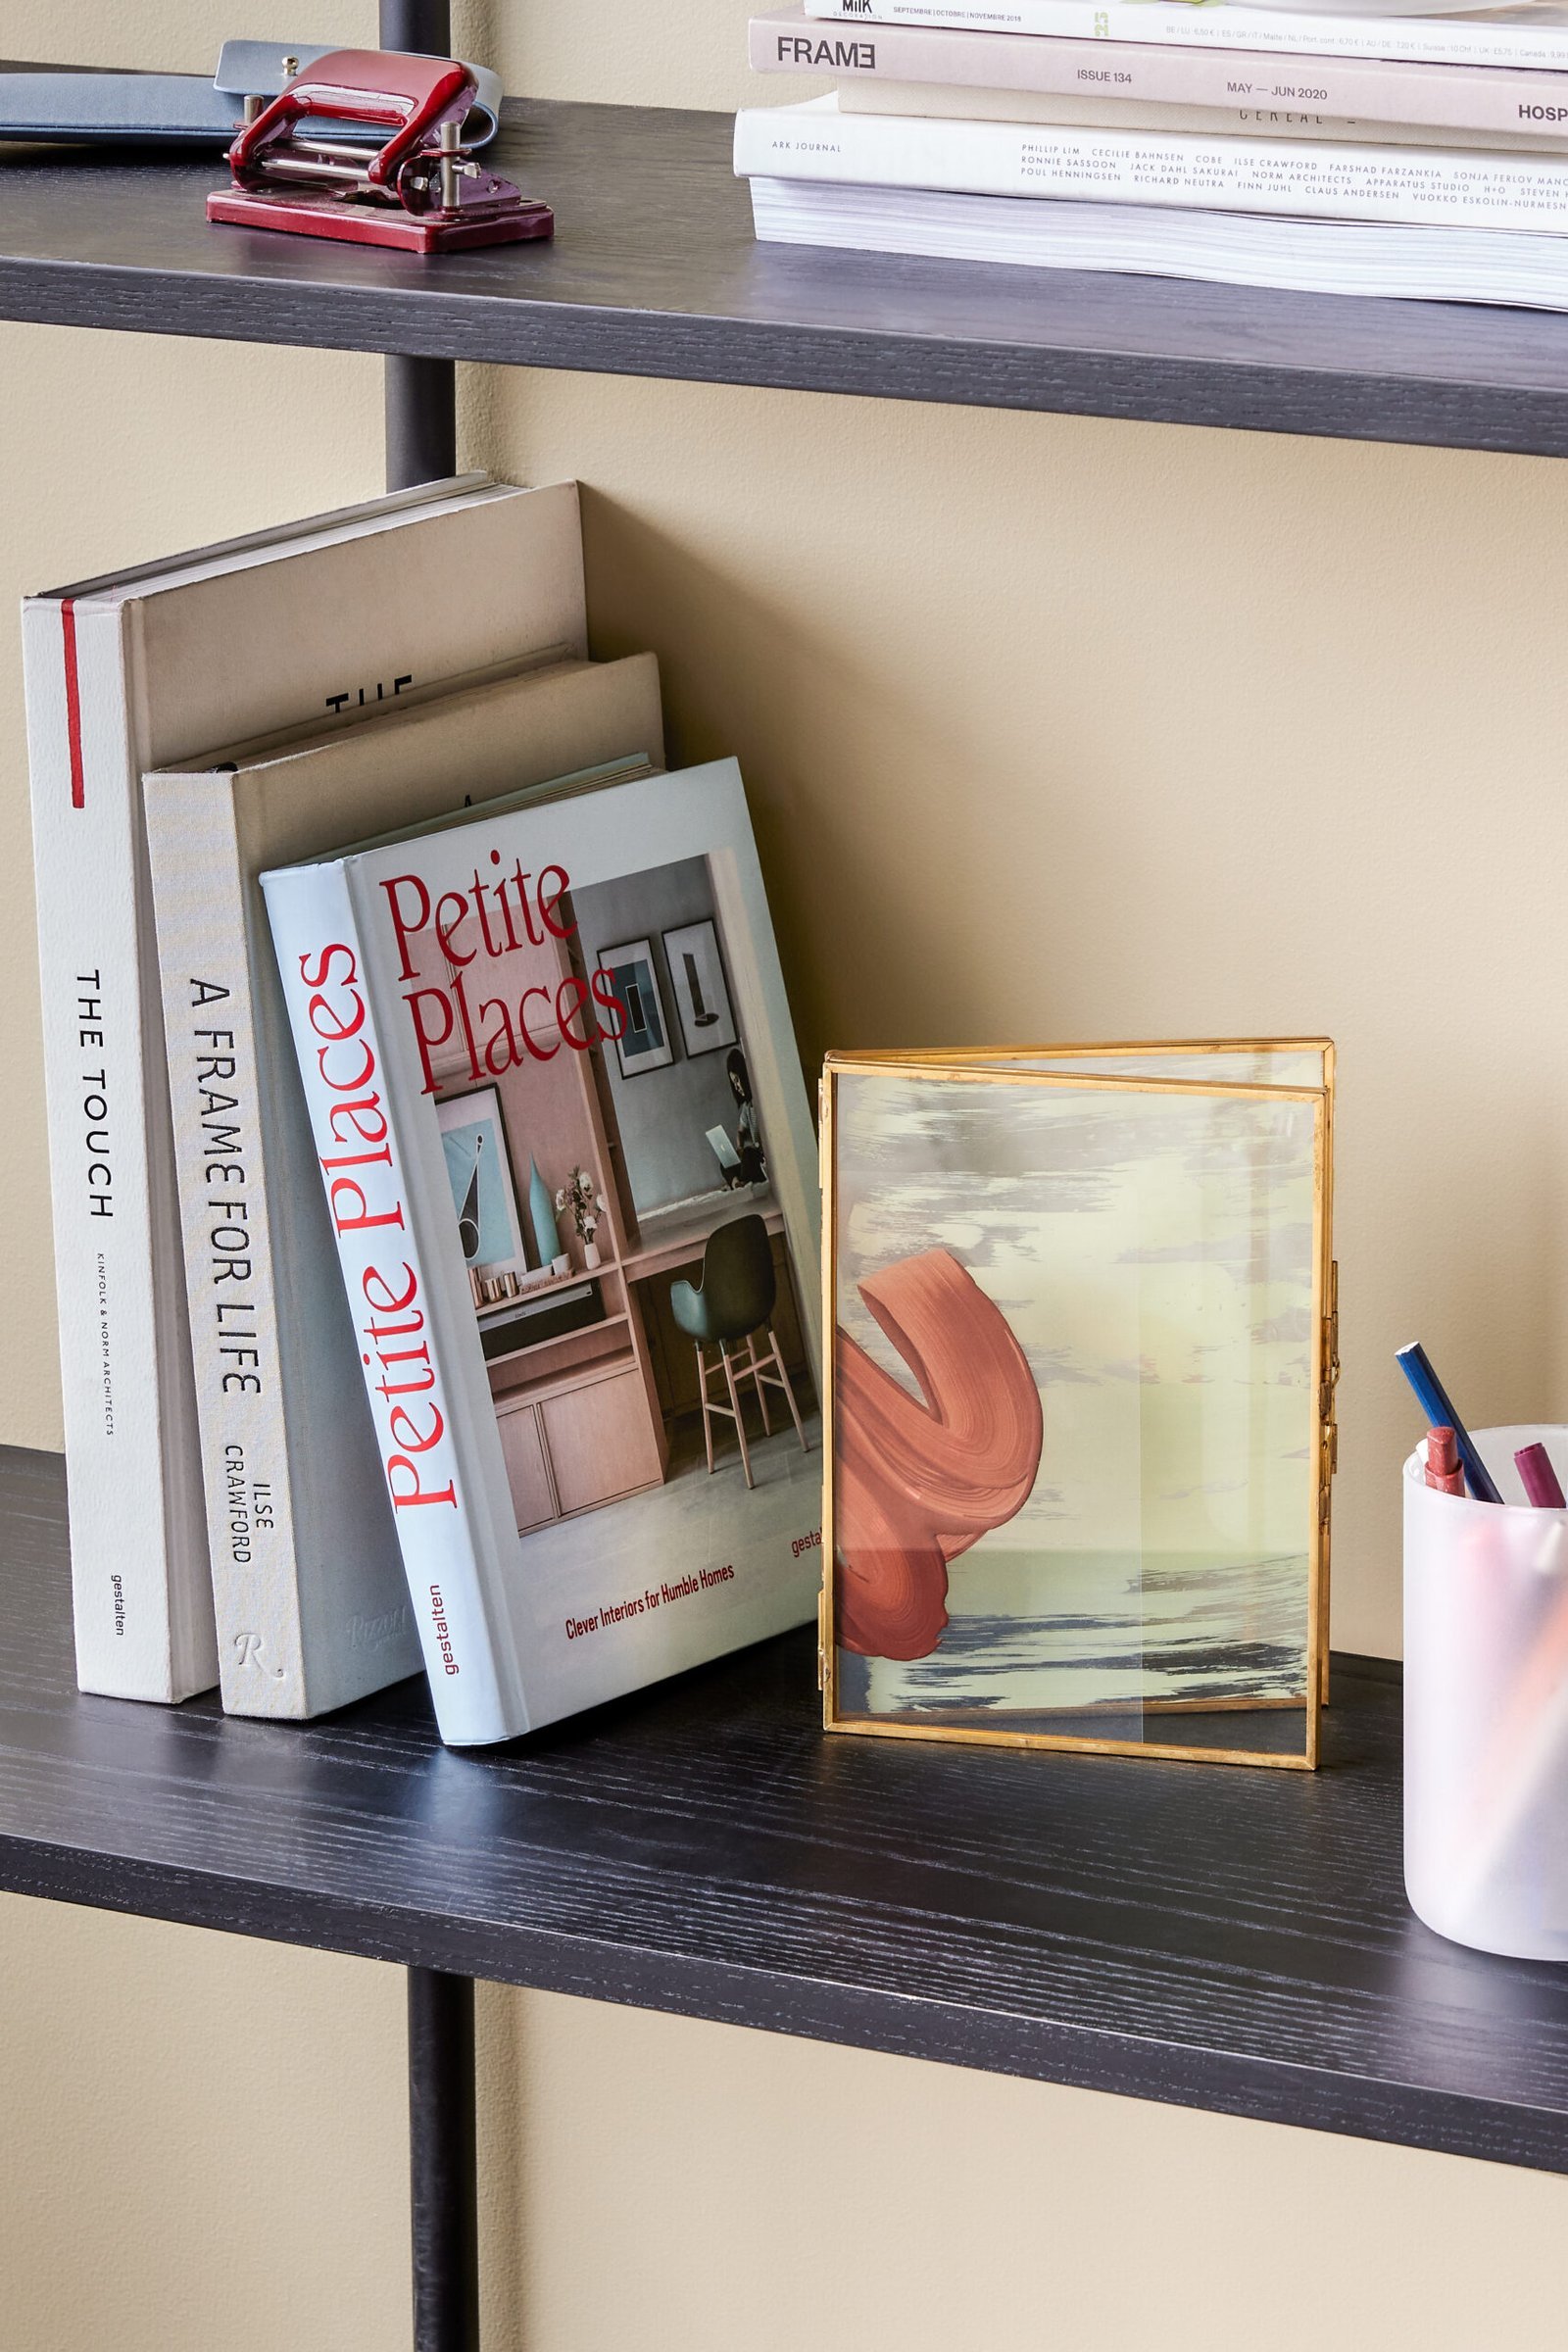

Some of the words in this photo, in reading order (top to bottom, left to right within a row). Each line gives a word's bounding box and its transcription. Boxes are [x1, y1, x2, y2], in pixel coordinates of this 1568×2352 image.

[894, 6, 931, 16] SEPTEMBRE
[936, 9, 965, 19] OCTOBRE
[970, 12, 1005, 21] NOVEMBRE
[1006, 14, 1021, 23] 2018
[1077, 69, 1111, 82] ISSUE
[1114, 72, 1132, 84] 134
[1227, 82, 1252, 93] MAY
[1272, 86, 1296, 97] JUN
[1298, 88, 1328, 100] 2020
[772, 140, 791, 149] ARK
[796, 143, 841, 153] JOURNAL
[1021, 156, 1062, 166] RONNIE
[1066, 159, 1116, 169] SASSOON
[1193, 168, 1239, 176] SAKURAI
[1289, 173, 1352, 184] ARCHITECTS
[1366, 178, 1425, 189] APPARATUS
[1431, 182, 1470, 192] STUDIO
[1485, 186, 1505, 195] H+O
[1521, 188, 1559, 197] STEVEN
[1022, 144, 1058, 153] PHILLIP
[1092, 149, 1130, 159] CECILIE
[1135, 152, 1184, 162] BAHNSEN
[1234, 158, 1254, 167] ILSE
[1259, 160, 1317, 171] CRAWFORD
[1330, 164, 1377, 174] FARSHAD
[1382, 167, 1442, 178] FARZANKIA
[1453, 172, 1489, 181] SONJA
[1494, 174, 1533, 184] FERLOV
[1021, 168, 1047, 176] POUL
[1053, 171, 1121, 181] HENNINGSEN
[1134, 175, 1179, 185] RICHARD
[1185, 179, 1224, 188] NEUTRA
[1238, 181, 1262, 190] FINN
[1267, 183, 1292, 193] JUHL
[1305, 186, 1338, 195] CLAUS
[1344, 188, 1399, 199] ANDERSEN
[1413, 194, 1457, 204] VUOKKO
[378, 850, 578, 982] Petite
[76, 969, 104, 1048] THE
[190, 977, 230, 1007] A
[402, 967, 628, 1095] Places
[194, 1029, 245, 1185] FRAME
[298, 943, 406, 1240] Places
[81, 1068, 113, 1217] TOUCH
[208, 1200, 252, 1285] FOR
[98, 1252, 108, 1304] KINFOLK
[101, 1322, 110, 1357] NORM
[217, 1302, 262, 1396] LIFE
[103, 1361, 114, 1436] ARCHITECTS
[362, 1260, 459, 1515] Petite
[224, 1445, 252, 1564] CRAWFORD
[253, 1483, 273, 1531] ILSE
[792, 1527, 822, 1557] gesta
[111, 1574, 125, 1636] gestalten
[429, 1585, 460, 1676] gestalten
[565, 1617, 599, 1640] Clever
[599, 1598, 645, 1627] Interiors
[645, 1592, 661, 1610] for
[661, 1575, 700, 1604] Humble
[700, 1565, 735, 1589] Homes
